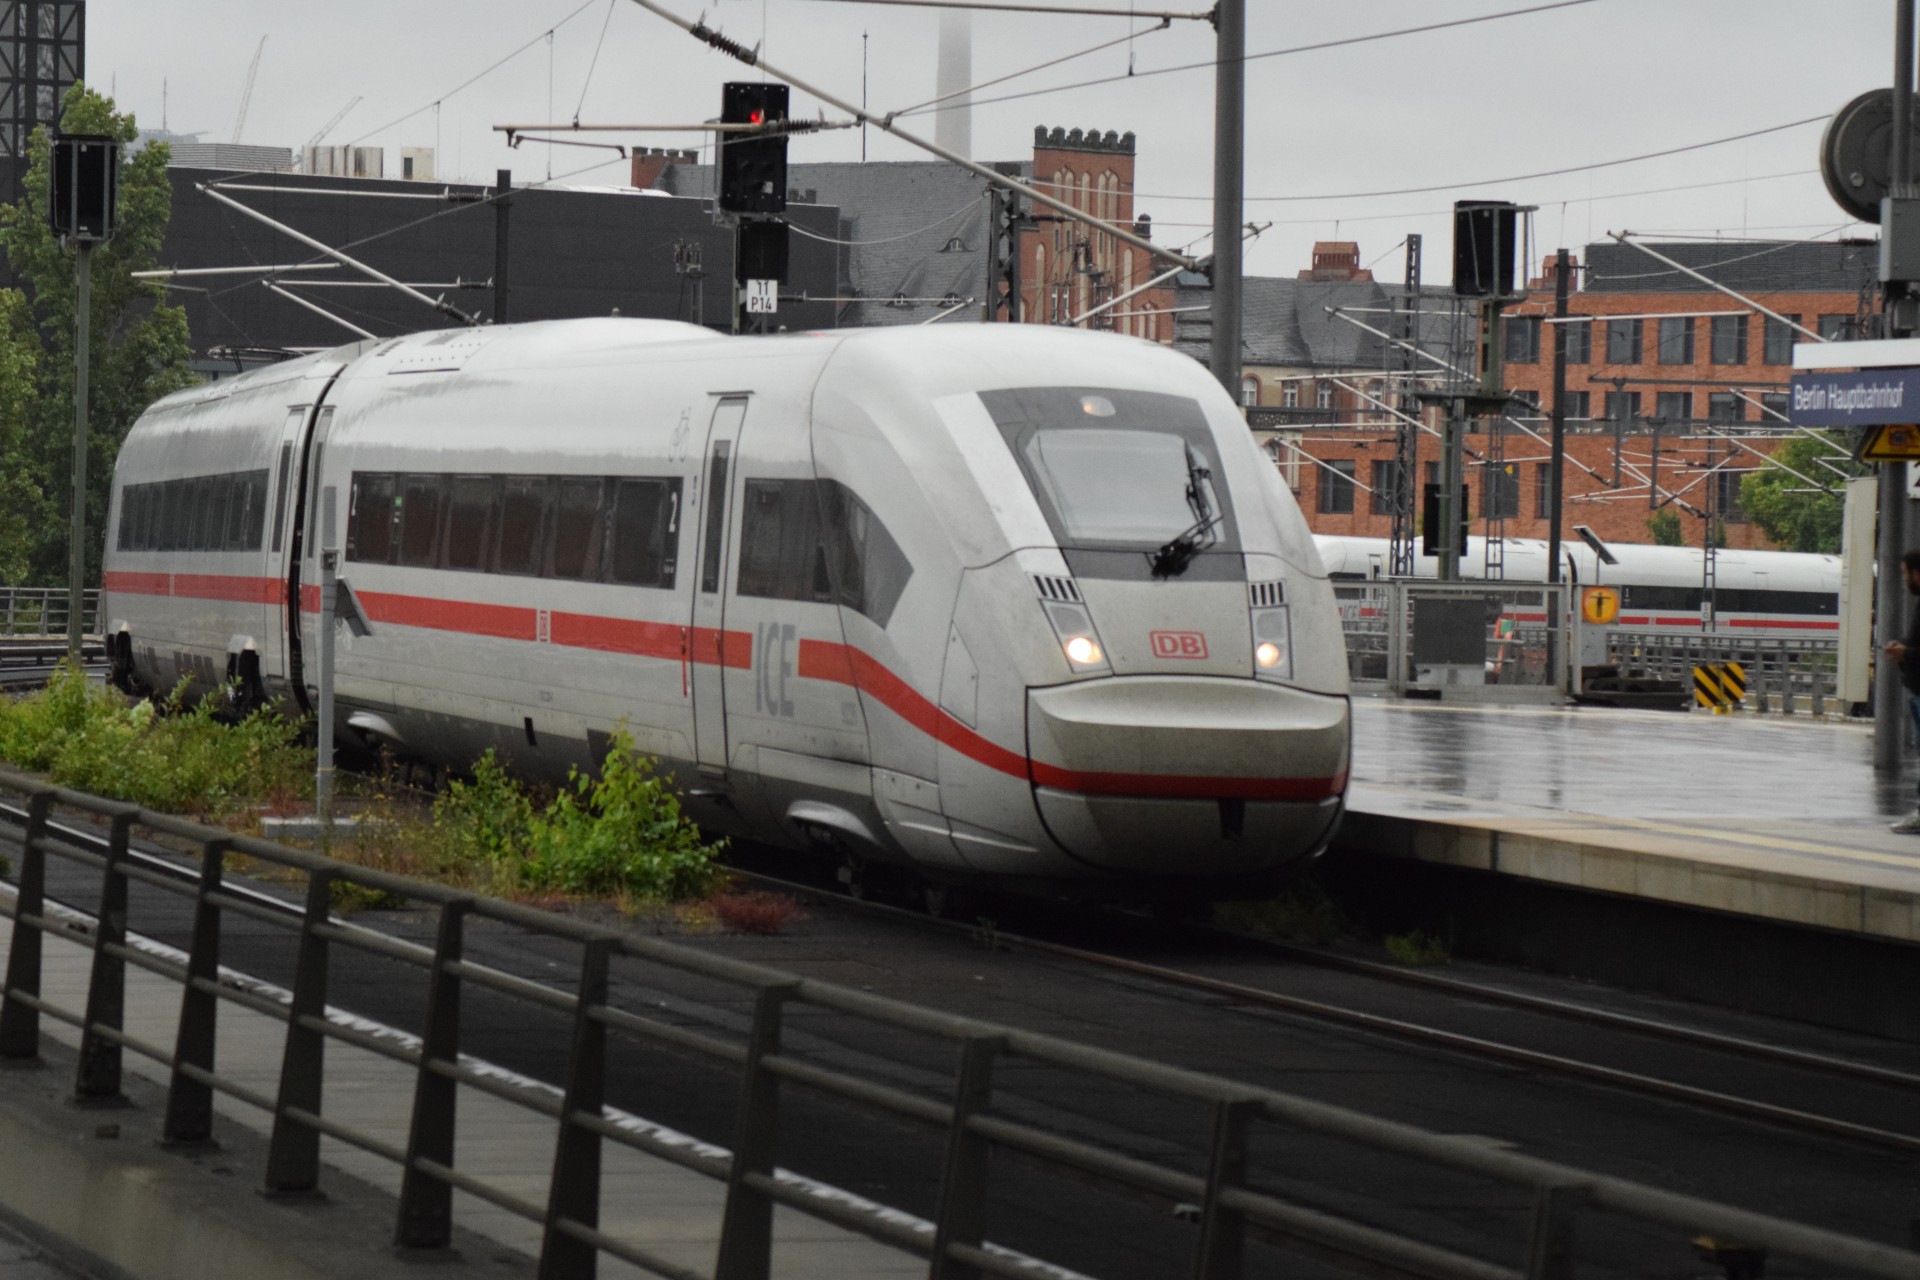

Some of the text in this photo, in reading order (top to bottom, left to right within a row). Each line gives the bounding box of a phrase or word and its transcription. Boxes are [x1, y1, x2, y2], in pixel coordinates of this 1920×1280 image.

[751, 297, 772, 311] P14
[1794, 381, 1904, 415] Berlin Hauptbahnhof
[668, 491, 678, 533] 2
[1155, 633, 1203, 656] DB
[756, 621, 796, 718] ICE
